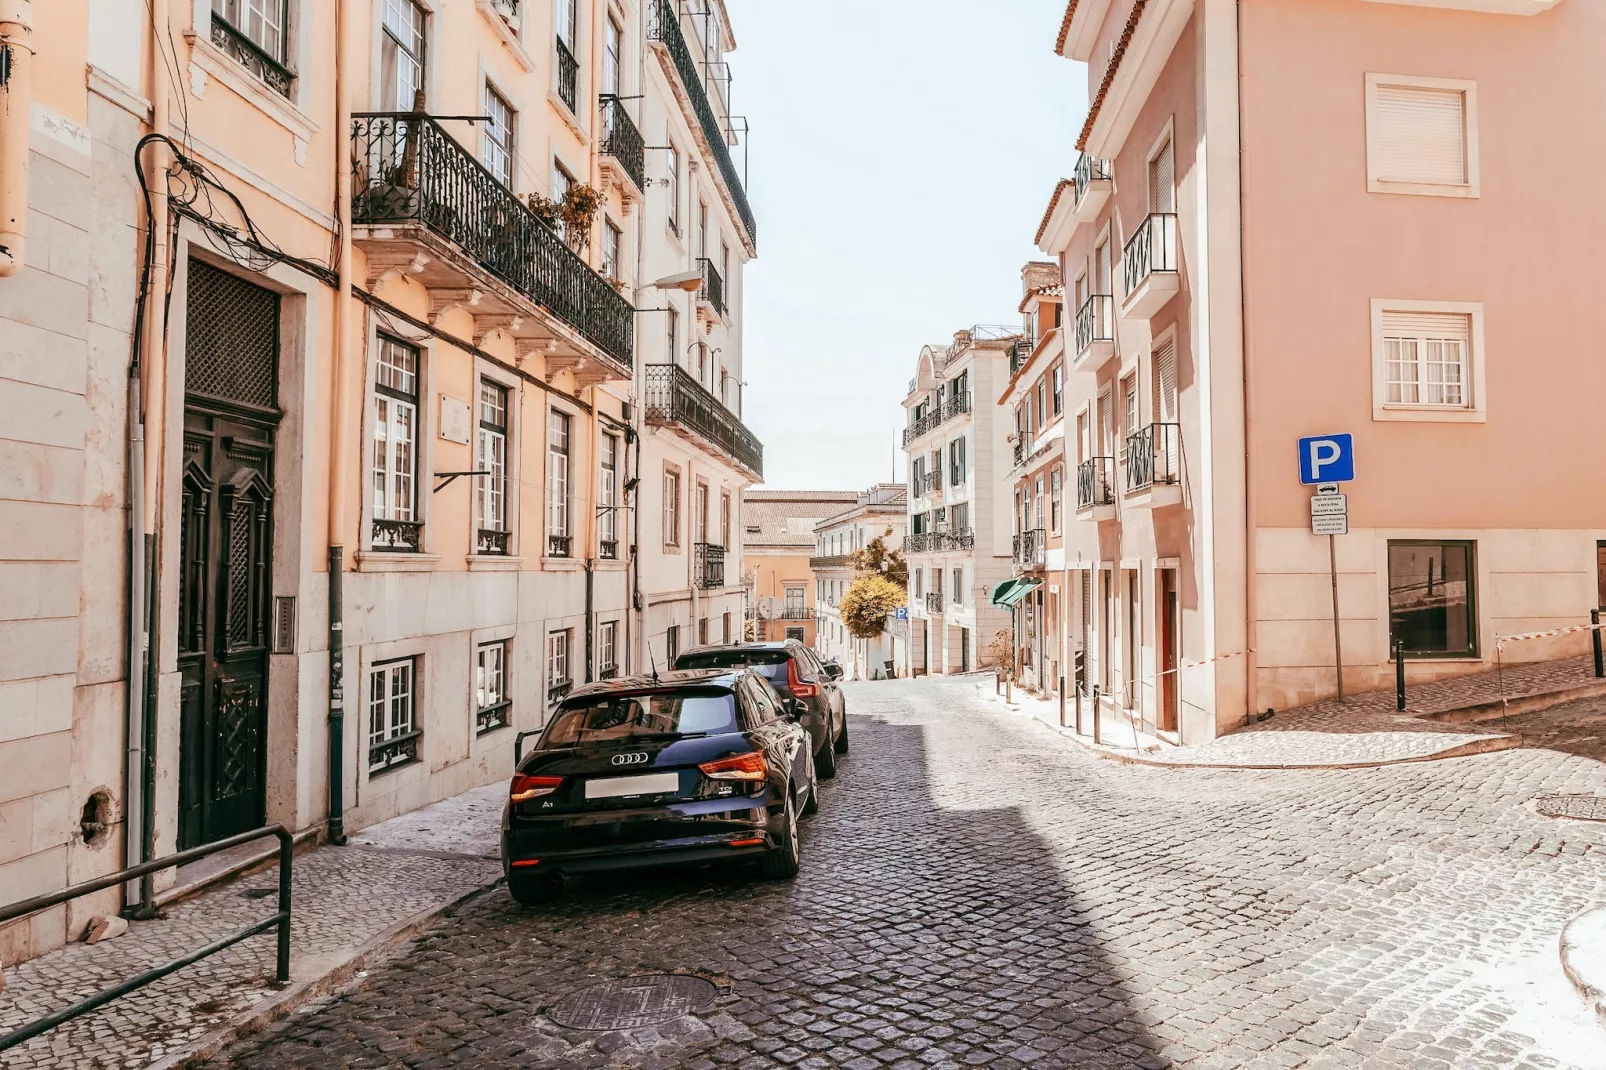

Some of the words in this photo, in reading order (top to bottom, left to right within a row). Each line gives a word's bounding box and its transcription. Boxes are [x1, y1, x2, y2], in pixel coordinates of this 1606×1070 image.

[1309, 439, 1341, 480] P
[898, 608, 906, 619] P
[541, 801, 554, 809] A1
